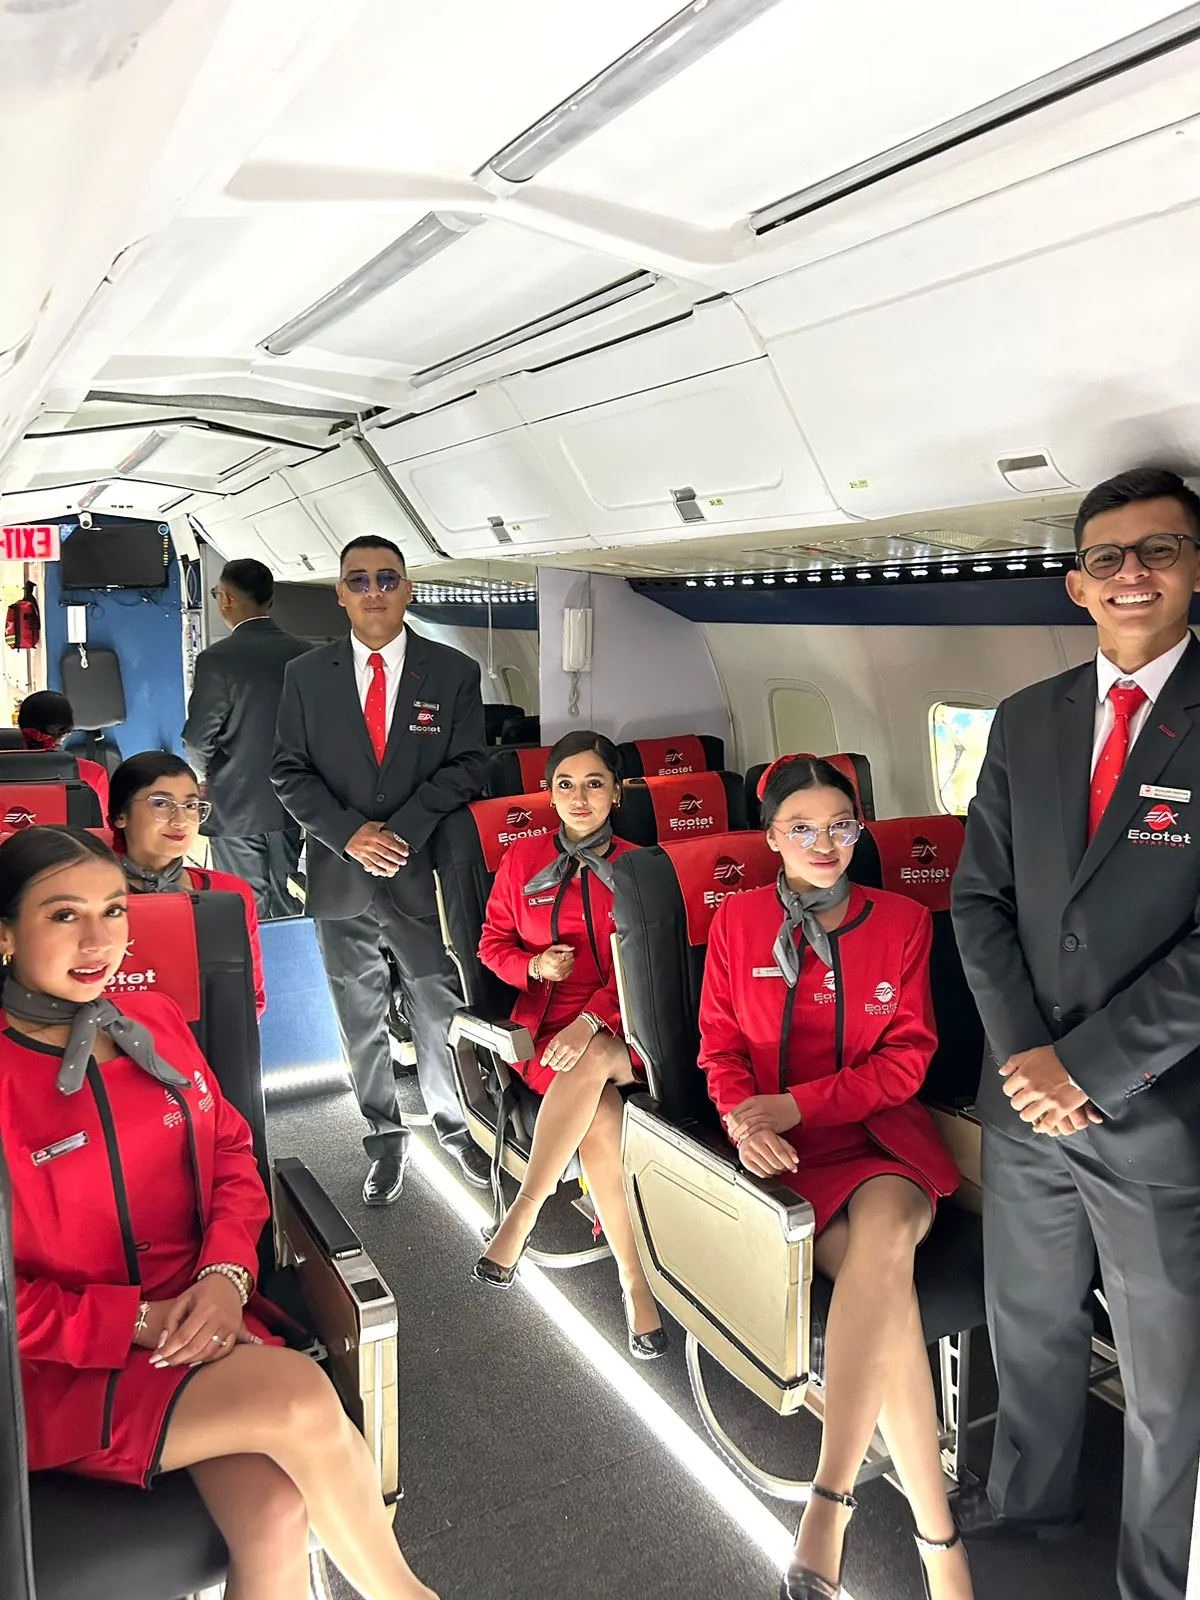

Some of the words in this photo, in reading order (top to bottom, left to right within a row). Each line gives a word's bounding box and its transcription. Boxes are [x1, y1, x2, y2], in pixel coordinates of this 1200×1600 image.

[409, 725, 441, 733] Ecotet
[658, 765, 693, 776] Ecotet
[669, 815, 714, 828] Ecotet
[498, 826, 548, 843] Ecotet
[1127, 829, 1191, 844] Ecotet
[900, 867, 950, 879] Ecotet
